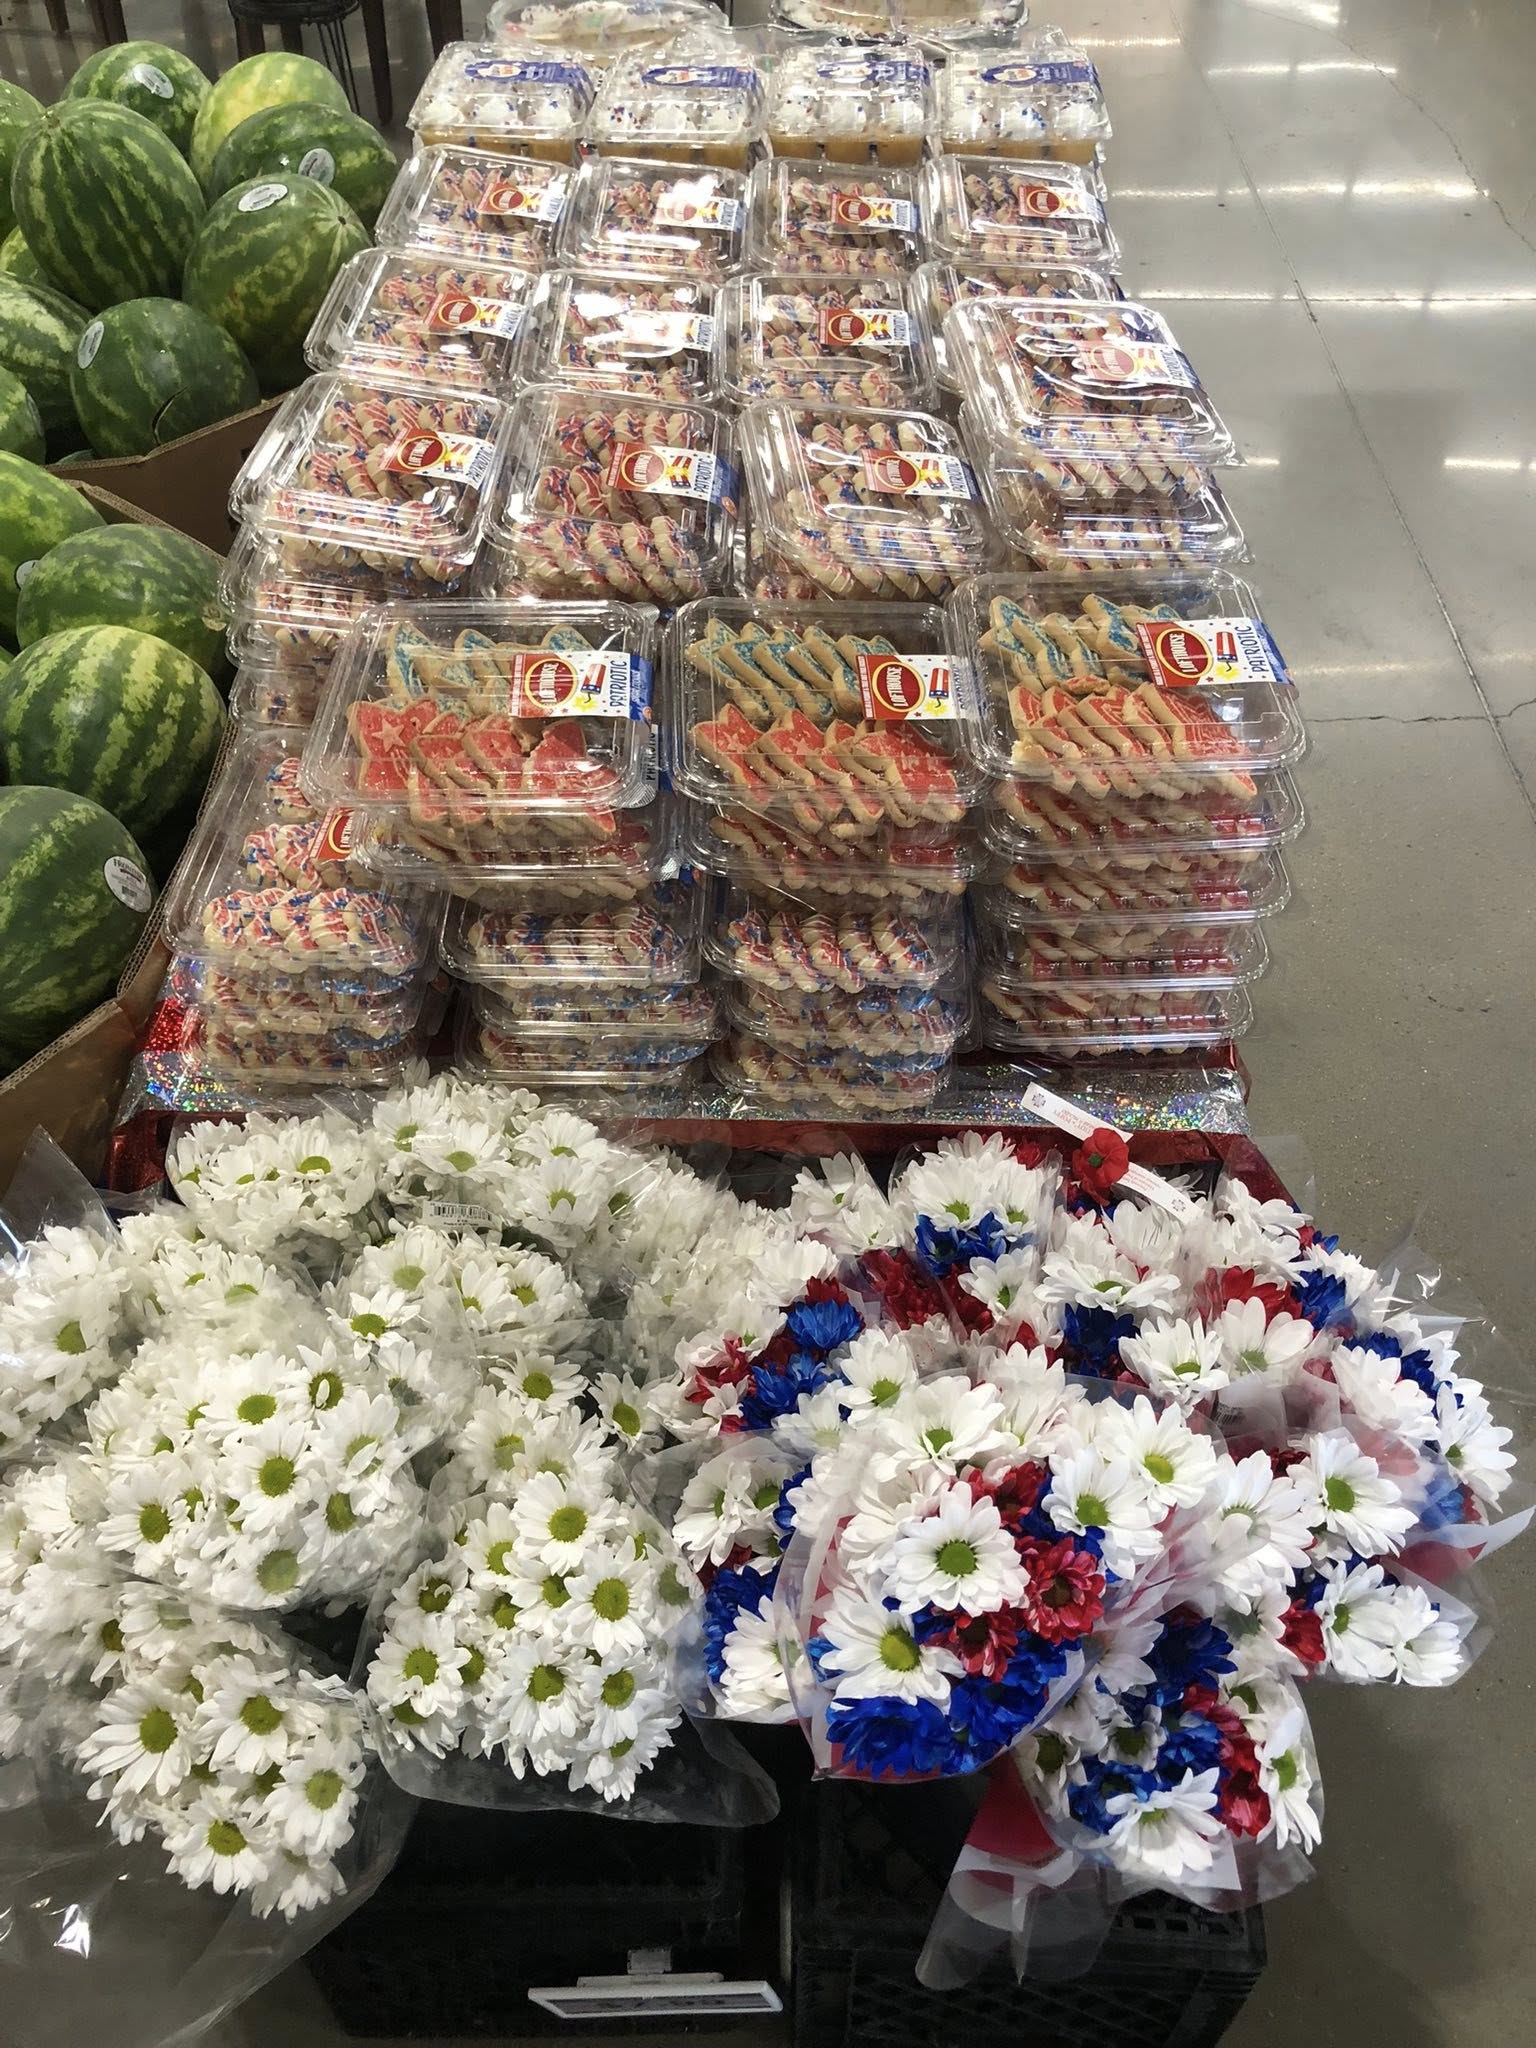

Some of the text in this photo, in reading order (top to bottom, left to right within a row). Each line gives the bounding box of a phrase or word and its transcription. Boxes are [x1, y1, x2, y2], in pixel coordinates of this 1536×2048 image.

[633, 454, 653, 484] LOFTHOUSE
[694, 458, 713, 494] PATRIOTIC
[945, 461, 967, 494] PATRIOTIC
[1169, 632, 1199, 673] LOFTHOUSE
[1234, 625, 1269, 673] PATRIOTIC
[540, 662, 559, 704] LOFTHOUSE
[610, 660, 628, 708] PATRIOTIC
[886, 666, 909, 707] LOFTHOUSE
